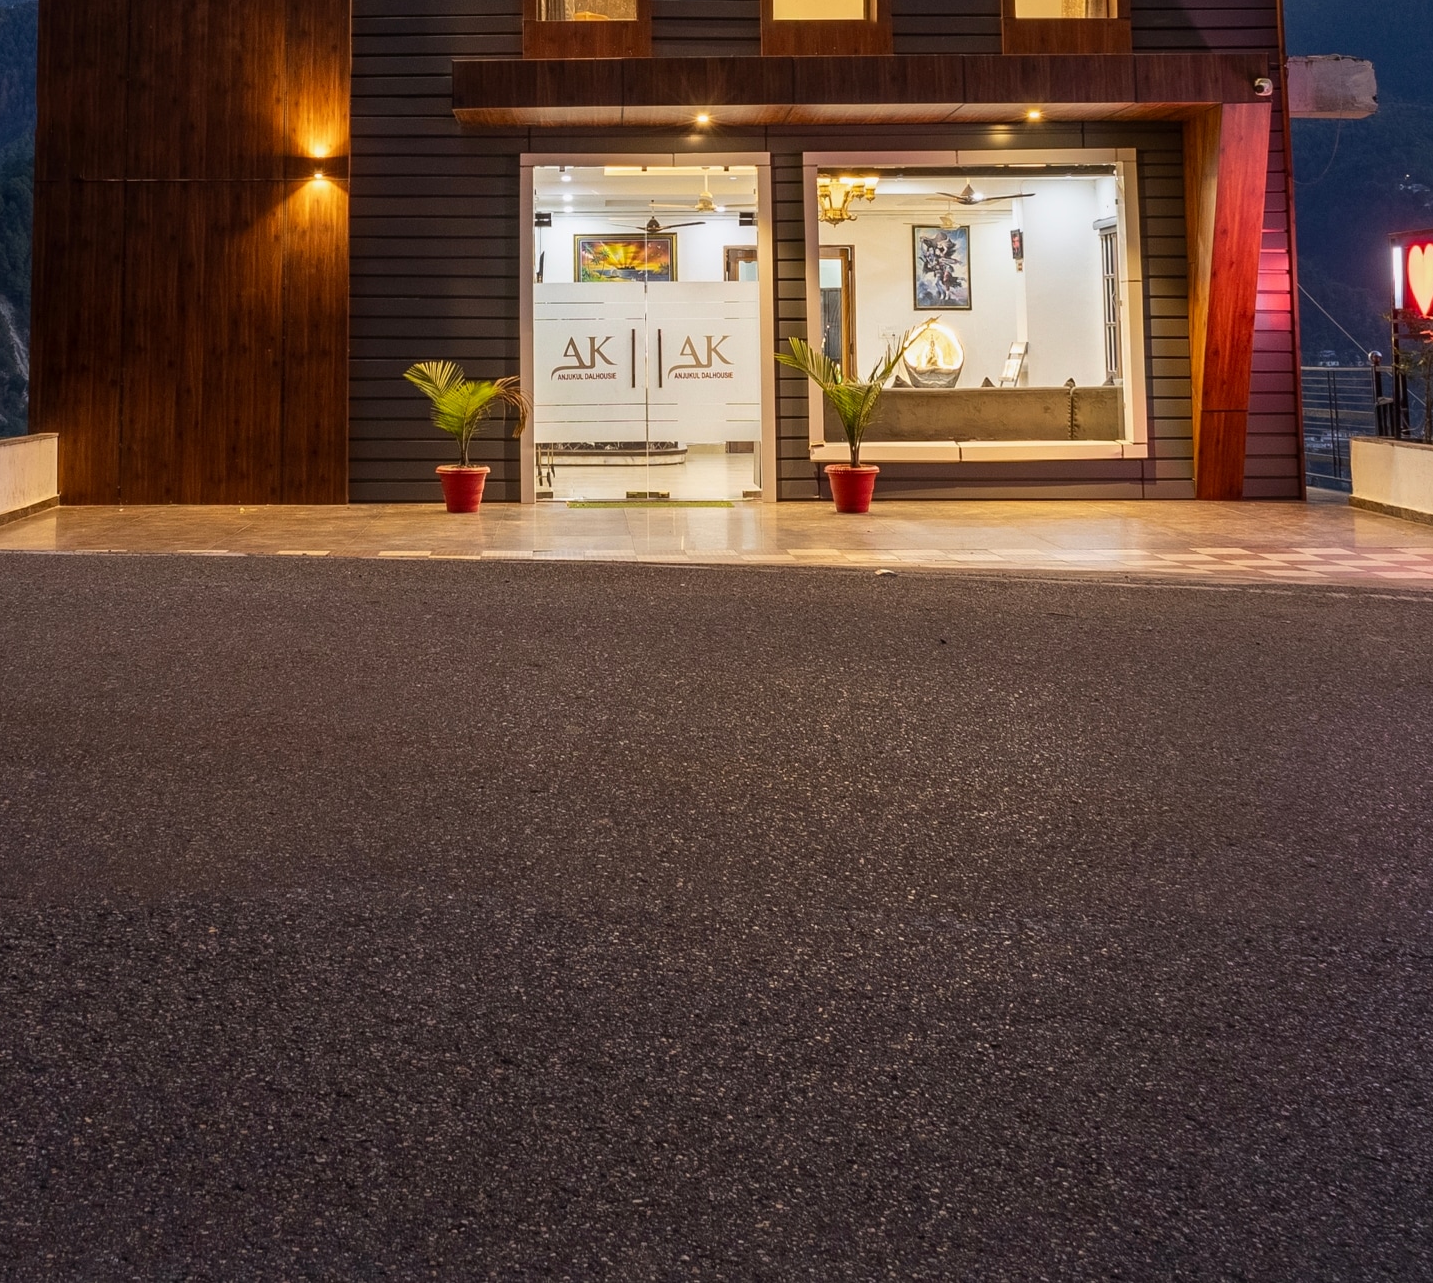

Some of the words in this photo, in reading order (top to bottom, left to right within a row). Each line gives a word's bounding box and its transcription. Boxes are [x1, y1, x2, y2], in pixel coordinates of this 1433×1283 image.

[1392, 246, 1404, 310] I
[557, 336, 618, 372] AK
[674, 335, 735, 371] AK
[557, 373, 584, 381] ANJUKUL
[585, 372, 617, 380] DALHOUSIE
[701, 371, 734, 379] DALHOUSIE
